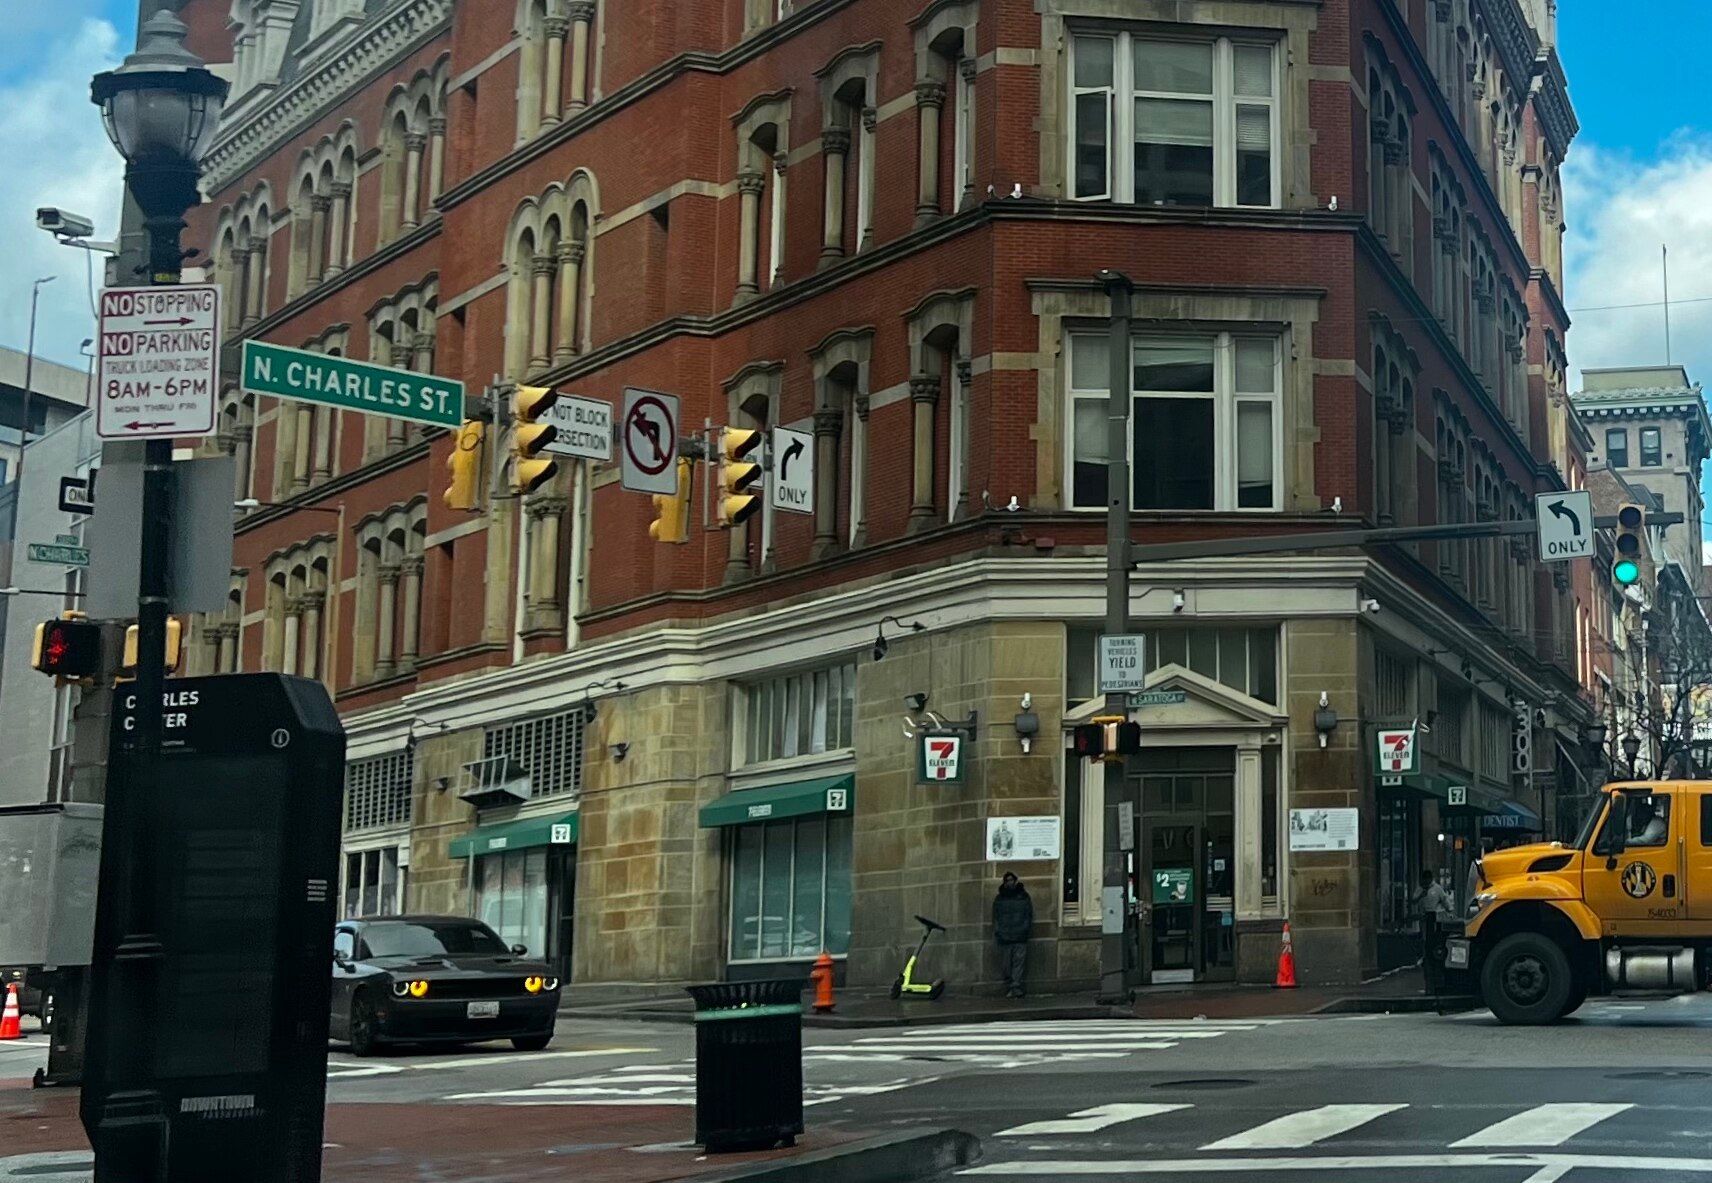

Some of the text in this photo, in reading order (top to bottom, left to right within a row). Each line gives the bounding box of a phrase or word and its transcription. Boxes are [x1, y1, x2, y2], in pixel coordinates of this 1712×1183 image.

[104, 293, 212, 315] NO STOPPING
[103, 332, 211, 355] NO PARKING
[141, 359, 181, 373] LOADING
[184, 357, 209, 371] ZONE
[107, 377, 207, 399] 8AM-6PM
[253, 356, 453, 415] N. CHARLES ST.
[552, 404, 572, 421] NOT
[575, 407, 608, 427] BLOCK
[779, 486, 807, 504] ONLY
[1548, 539, 1587, 554] ONLY
[1109, 657, 1136, 668] YIELD
[1483, 815, 1520, 827] DENTIST
